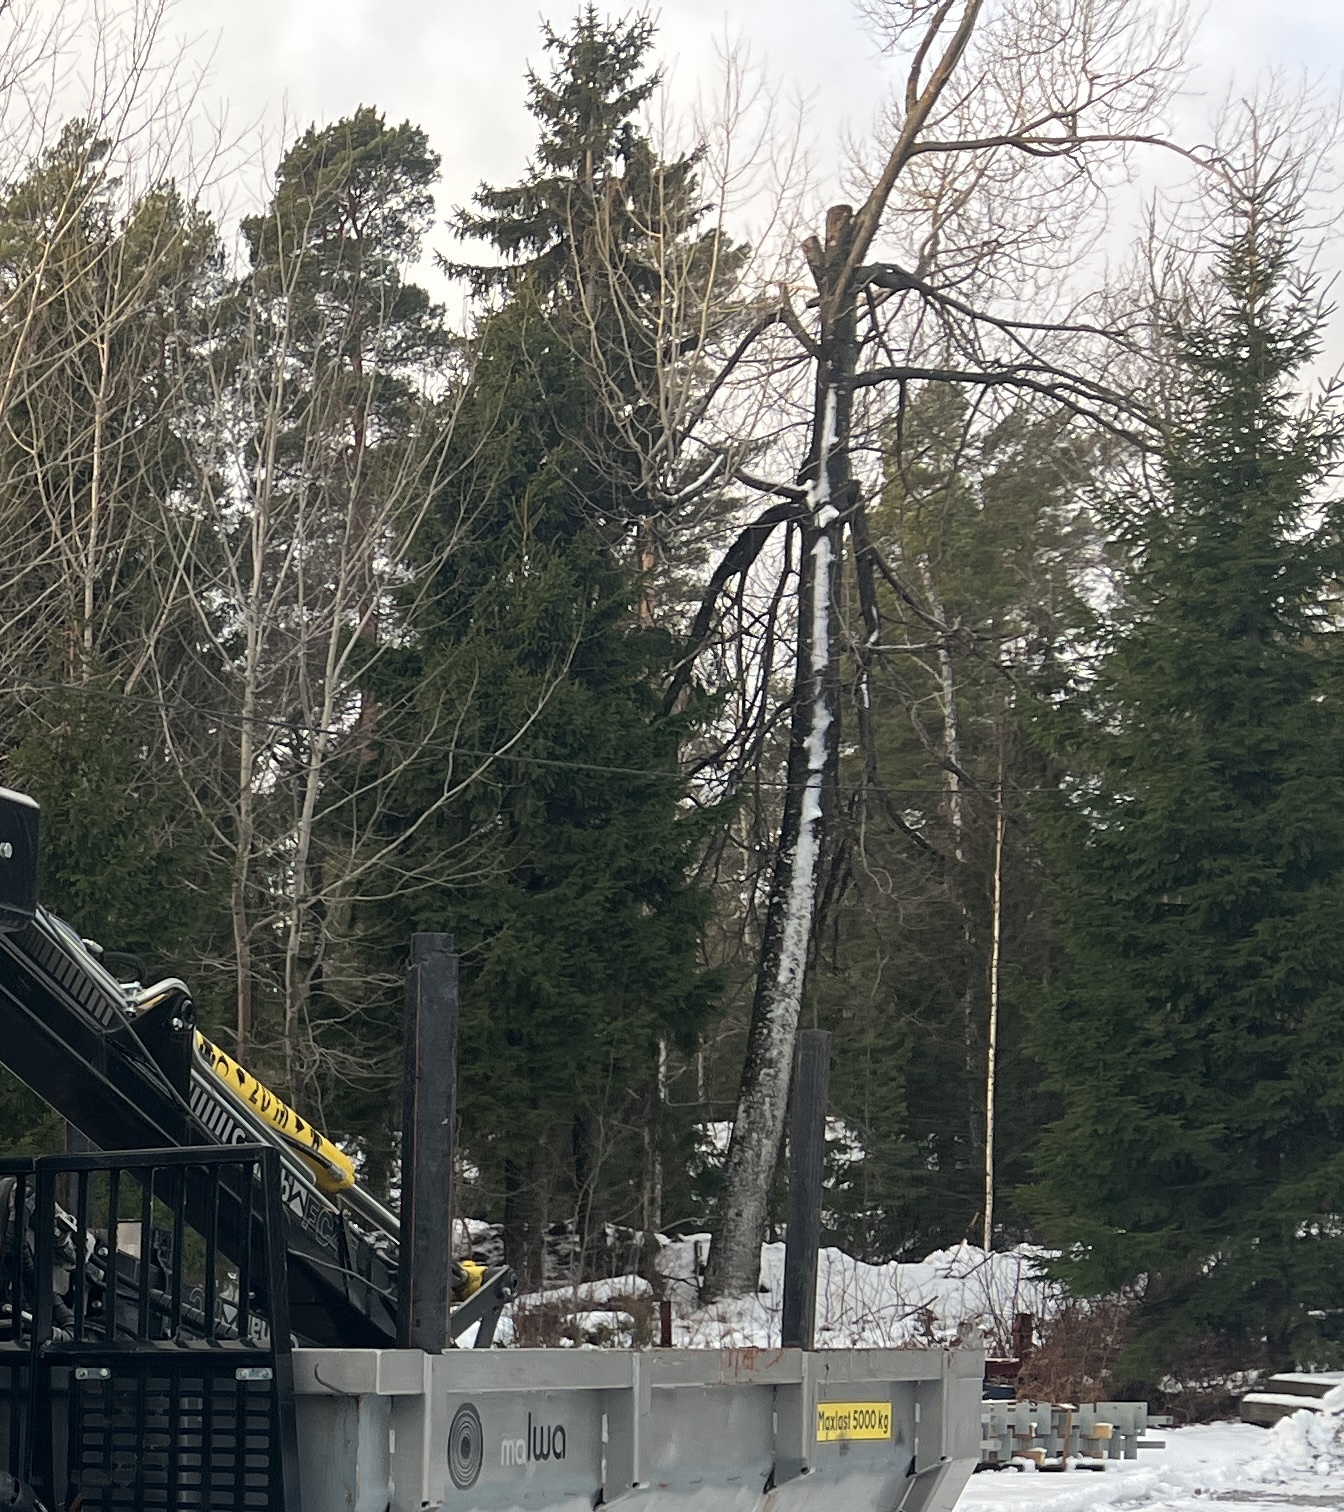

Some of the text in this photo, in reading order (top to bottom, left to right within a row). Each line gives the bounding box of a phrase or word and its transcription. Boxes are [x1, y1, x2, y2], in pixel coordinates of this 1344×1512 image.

[818, 1409, 889, 1434] Maxlast 5000 kg
